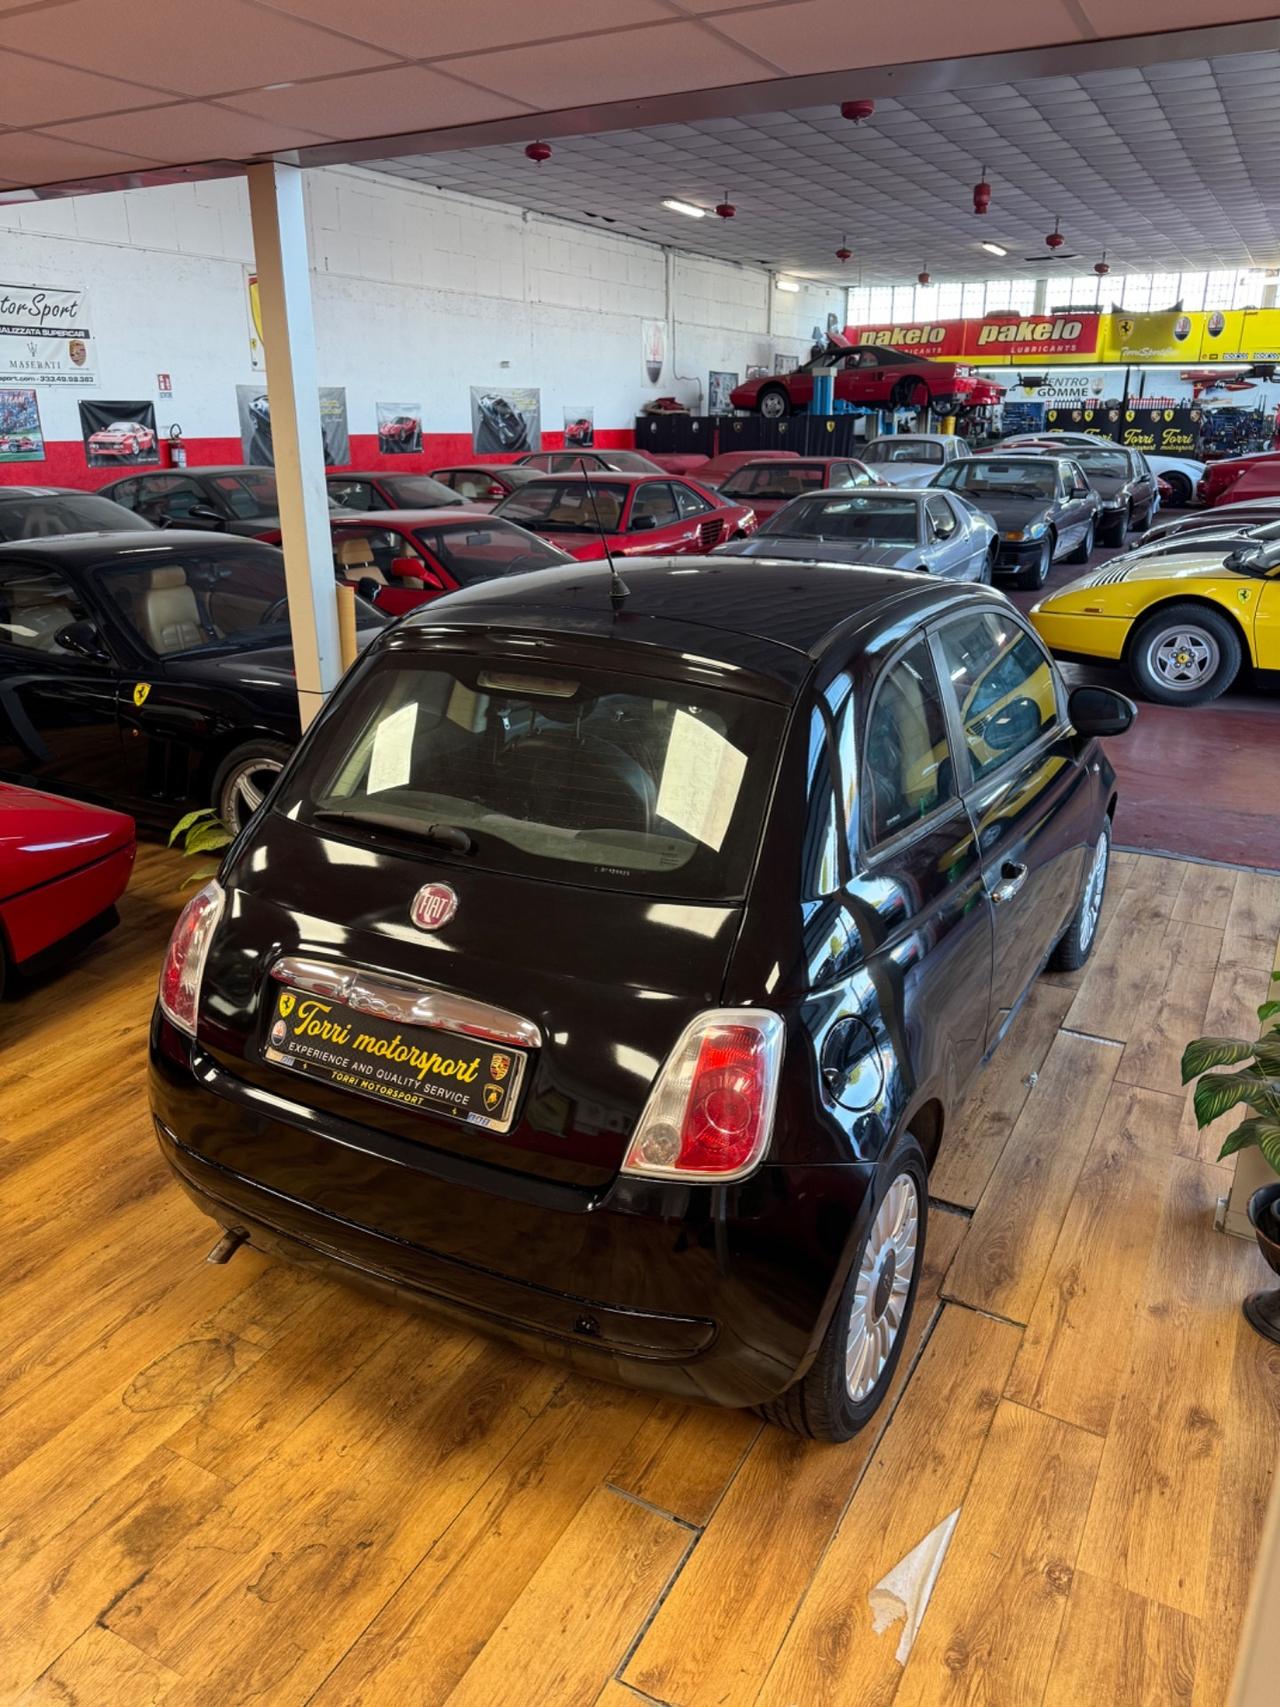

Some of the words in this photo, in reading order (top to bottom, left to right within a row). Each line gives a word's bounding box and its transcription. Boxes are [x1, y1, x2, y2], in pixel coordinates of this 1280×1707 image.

[977, 319, 1082, 345] pakelo
[1010, 345, 1077, 354] LUBRICANTS
[9, 360, 61, 370] MASERATI
[1047, 377, 1089, 386] ENTRO
[1037, 387, 1089, 397] GOMME
[1123, 428, 1155, 445] Torri
[1162, 428, 1193, 445] Torri
[419, 893, 449, 919] FIAT
[293, 1000, 352, 1045] Torri
[352, 1033, 481, 1083] motorsport
[288, 1042, 350, 1068] EXPERIENCE
[351, 1062, 373, 1075] AND
[376, 1069, 422, 1089] QUALITY
[423, 1083, 470, 1105] SERVICE
[331, 1071, 359, 1085] TORRI
[360, 1080, 424, 1105] MOTORSPORT
